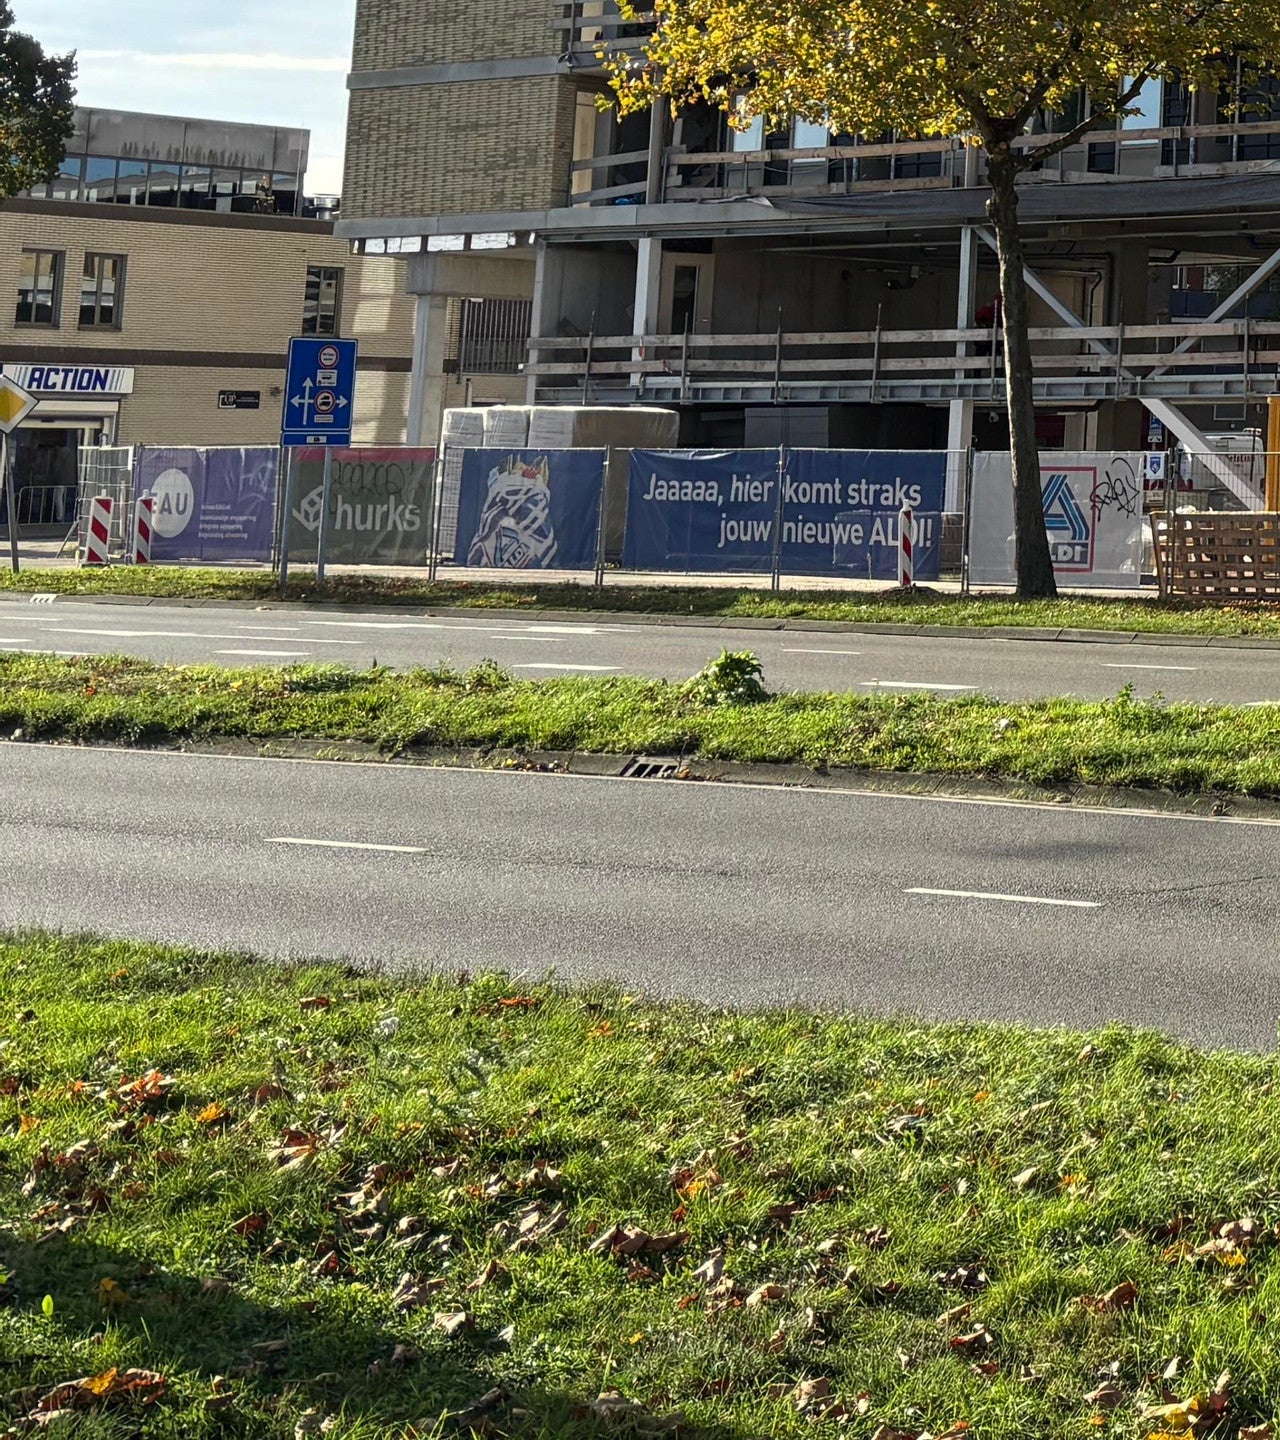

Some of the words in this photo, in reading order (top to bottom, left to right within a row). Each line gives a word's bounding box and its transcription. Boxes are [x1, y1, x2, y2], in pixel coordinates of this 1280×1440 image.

[27, 367, 109, 391] ACTION
[643, 473, 723, 507] Jaaaaa,
[730, 474, 774, 502] hier
[784, 475, 841, 504] komt
[847, 477, 922, 507] straks
[335, 494, 420, 531] hurks
[717, 513, 772, 548] jouw
[782, 515, 864, 545] nieuwe
